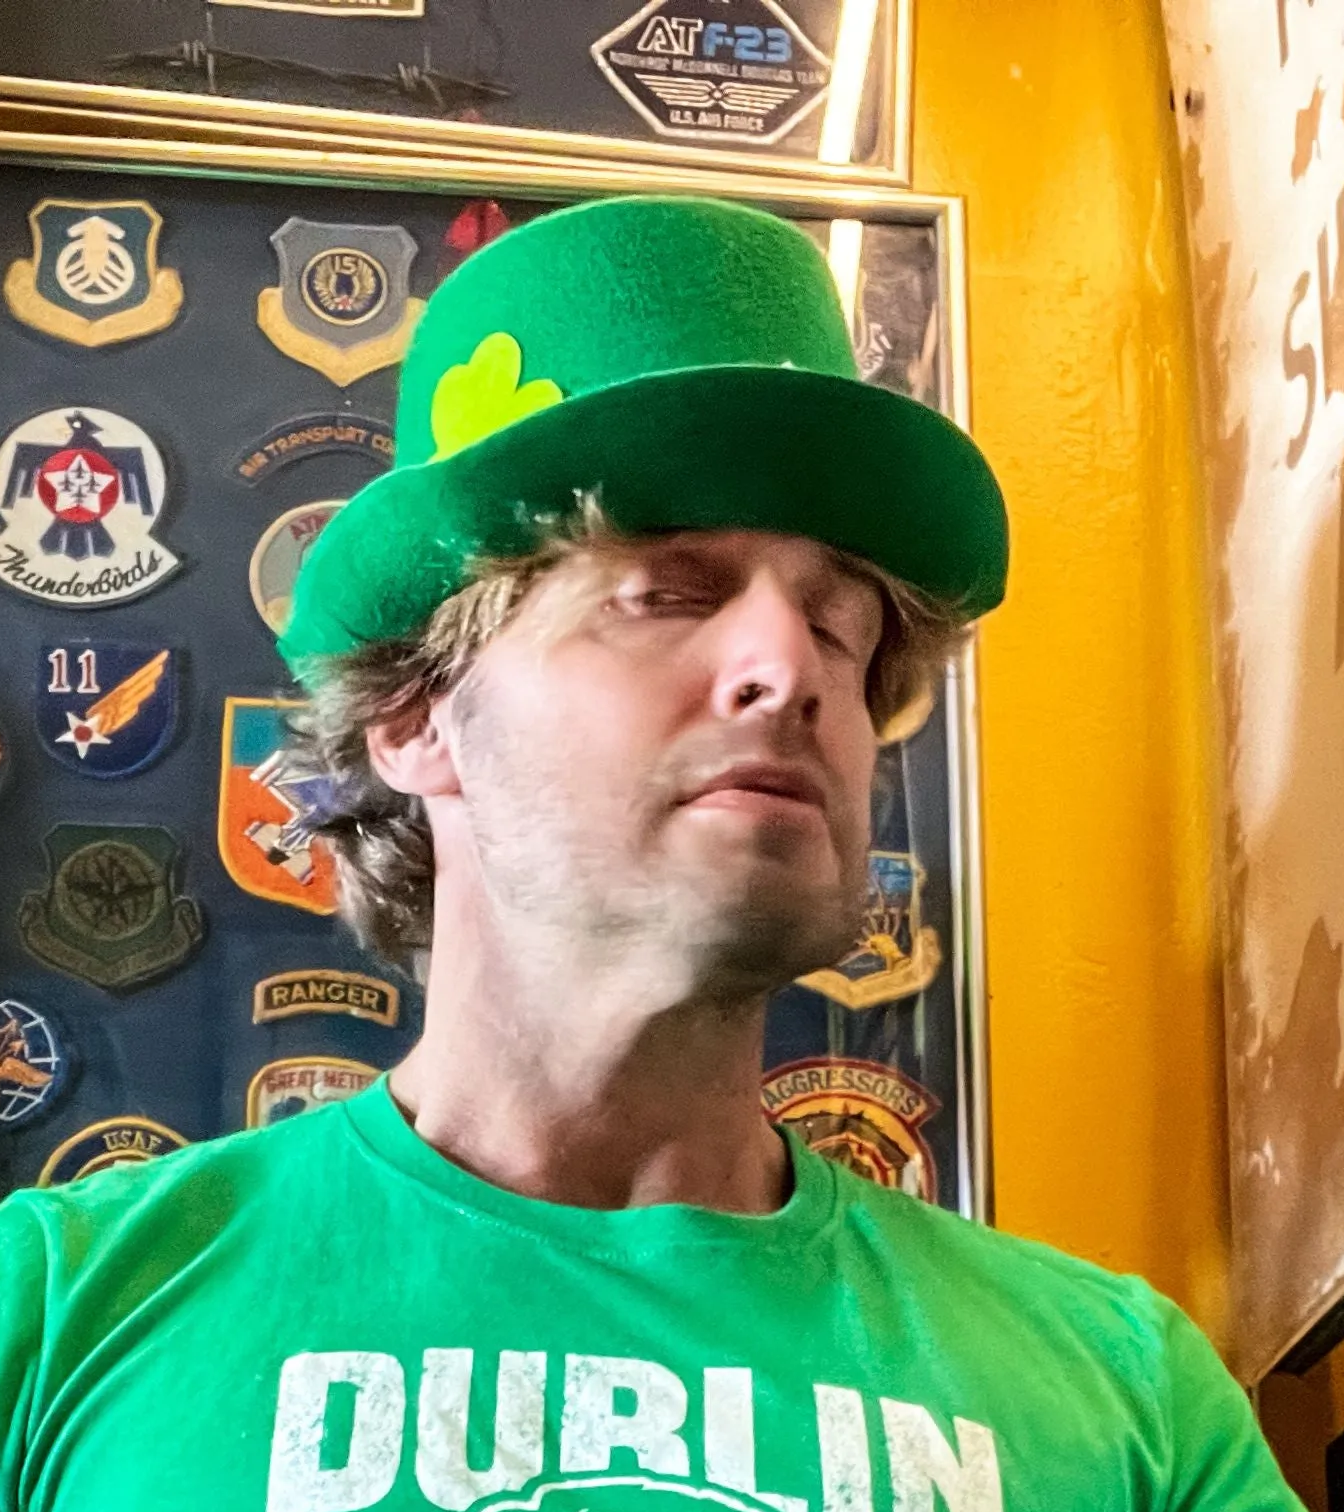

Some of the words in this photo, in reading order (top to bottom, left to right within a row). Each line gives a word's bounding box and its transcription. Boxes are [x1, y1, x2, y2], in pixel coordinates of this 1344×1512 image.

[47, 648, 101, 694] 11
[271, 980, 380, 1011] RANGER
[761, 1067, 920, 1116] AGGRESSORS
[102, 1128, 163, 1152] USAF
